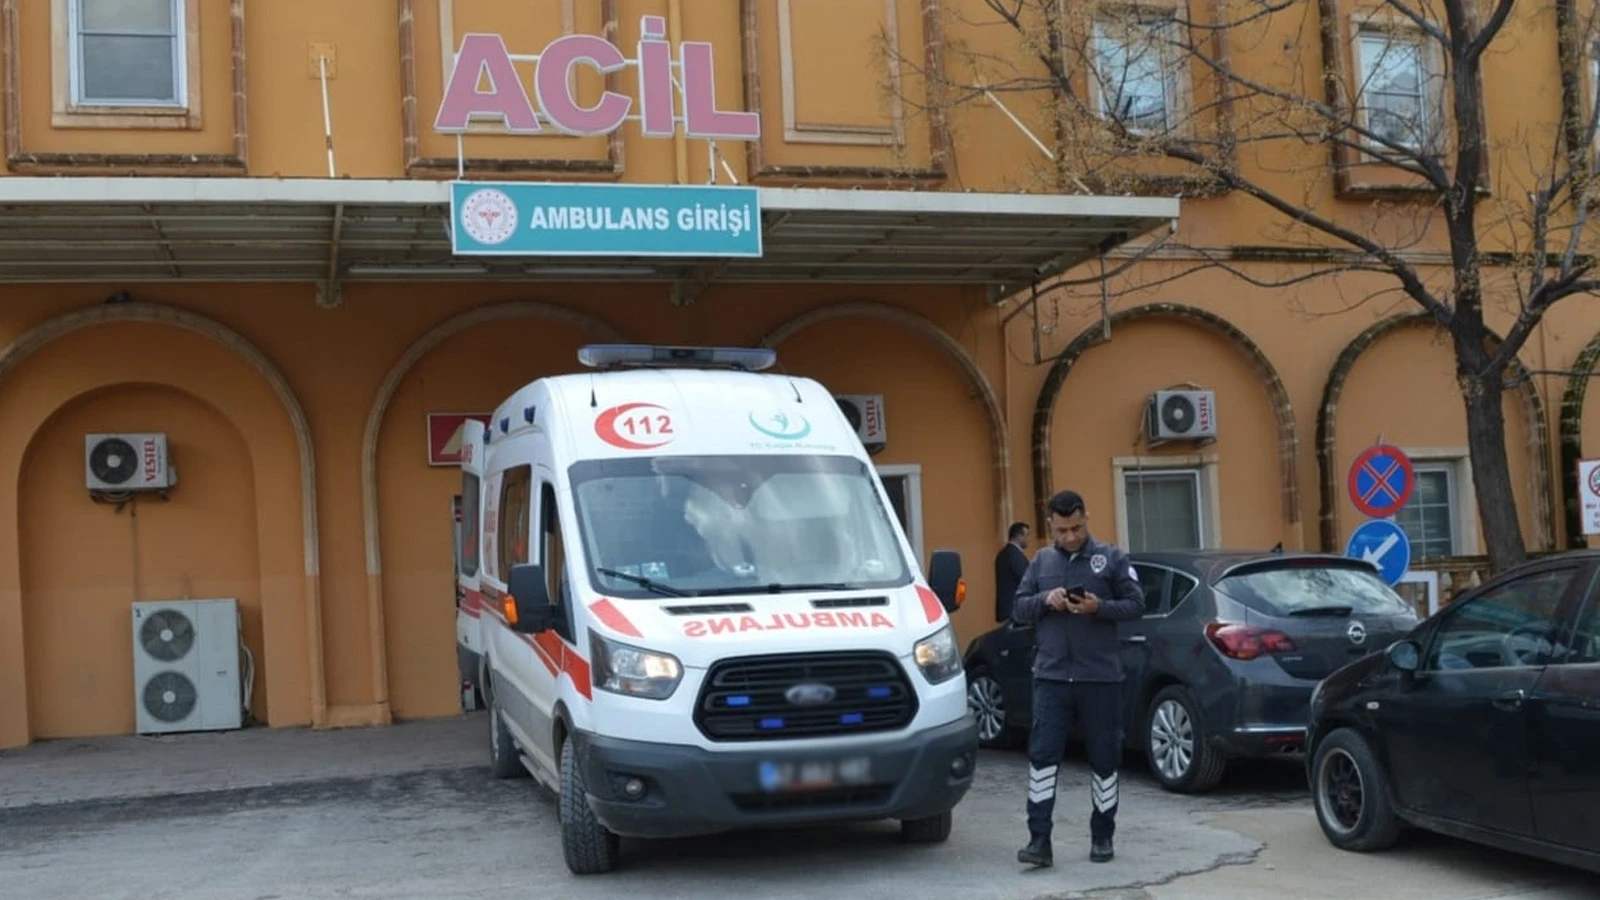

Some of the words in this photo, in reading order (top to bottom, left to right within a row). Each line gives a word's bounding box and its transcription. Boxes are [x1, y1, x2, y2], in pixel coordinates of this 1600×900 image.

[434, 15, 760, 139] ACİL
[530, 206, 670, 230] AMBULANS
[677, 203, 751, 237] GİRİŞİ
[623, 415, 673, 435] 112
[866, 397, 877, 437] VESTEL
[144, 437, 156, 482] VESTEL
